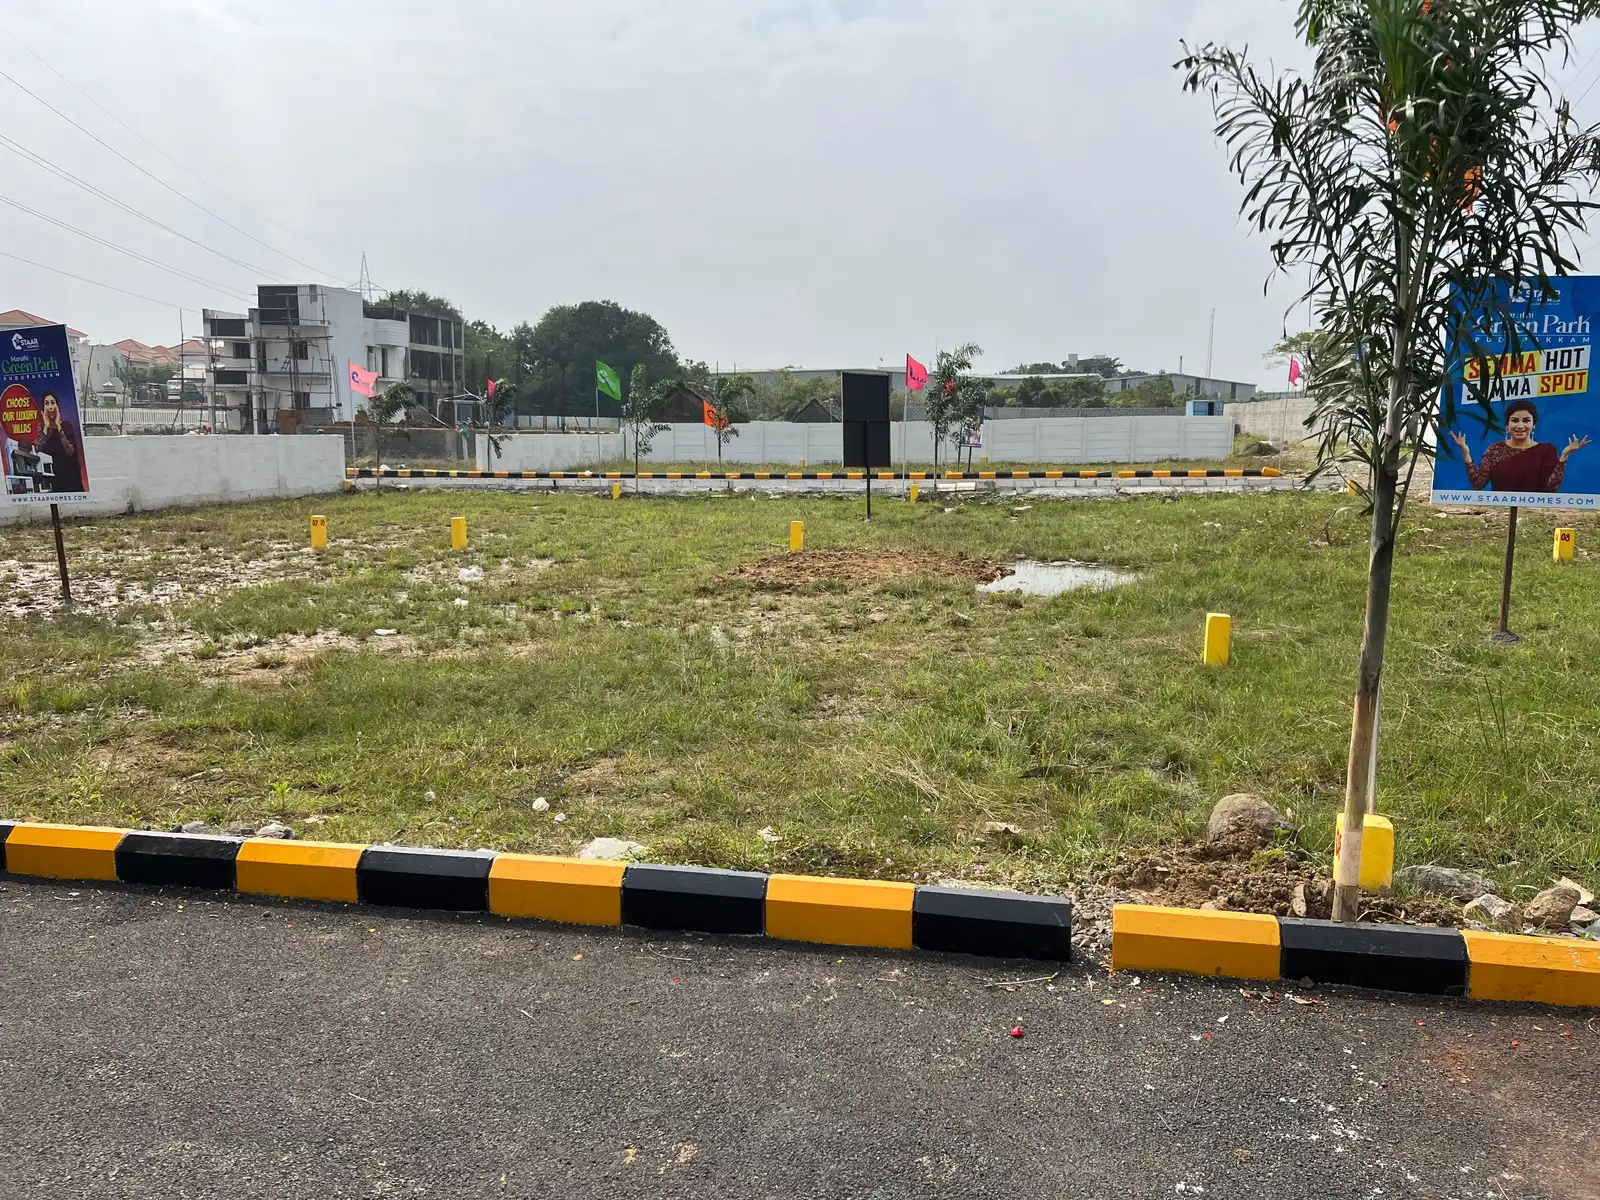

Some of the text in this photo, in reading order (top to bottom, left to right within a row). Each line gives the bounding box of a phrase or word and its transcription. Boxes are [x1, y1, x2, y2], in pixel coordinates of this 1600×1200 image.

[1542, 314, 1592, 334] Park
[21, 338, 39, 346] STAAR
[1, 356, 59, 374] Green Park
[1545, 347, 1585, 371] HOT
[1467, 372, 1587, 401] SMMA SPOT
[6, 397, 30, 408] CHOOSE
[2, 409, 38, 422] OUR LUXURY
[13, 423, 32, 434] VILLAS
[11, 495, 88, 503] WWW.STAARHOMES.COM
[1440, 493, 1595, 505] WWW.STAARHOMES.COM
